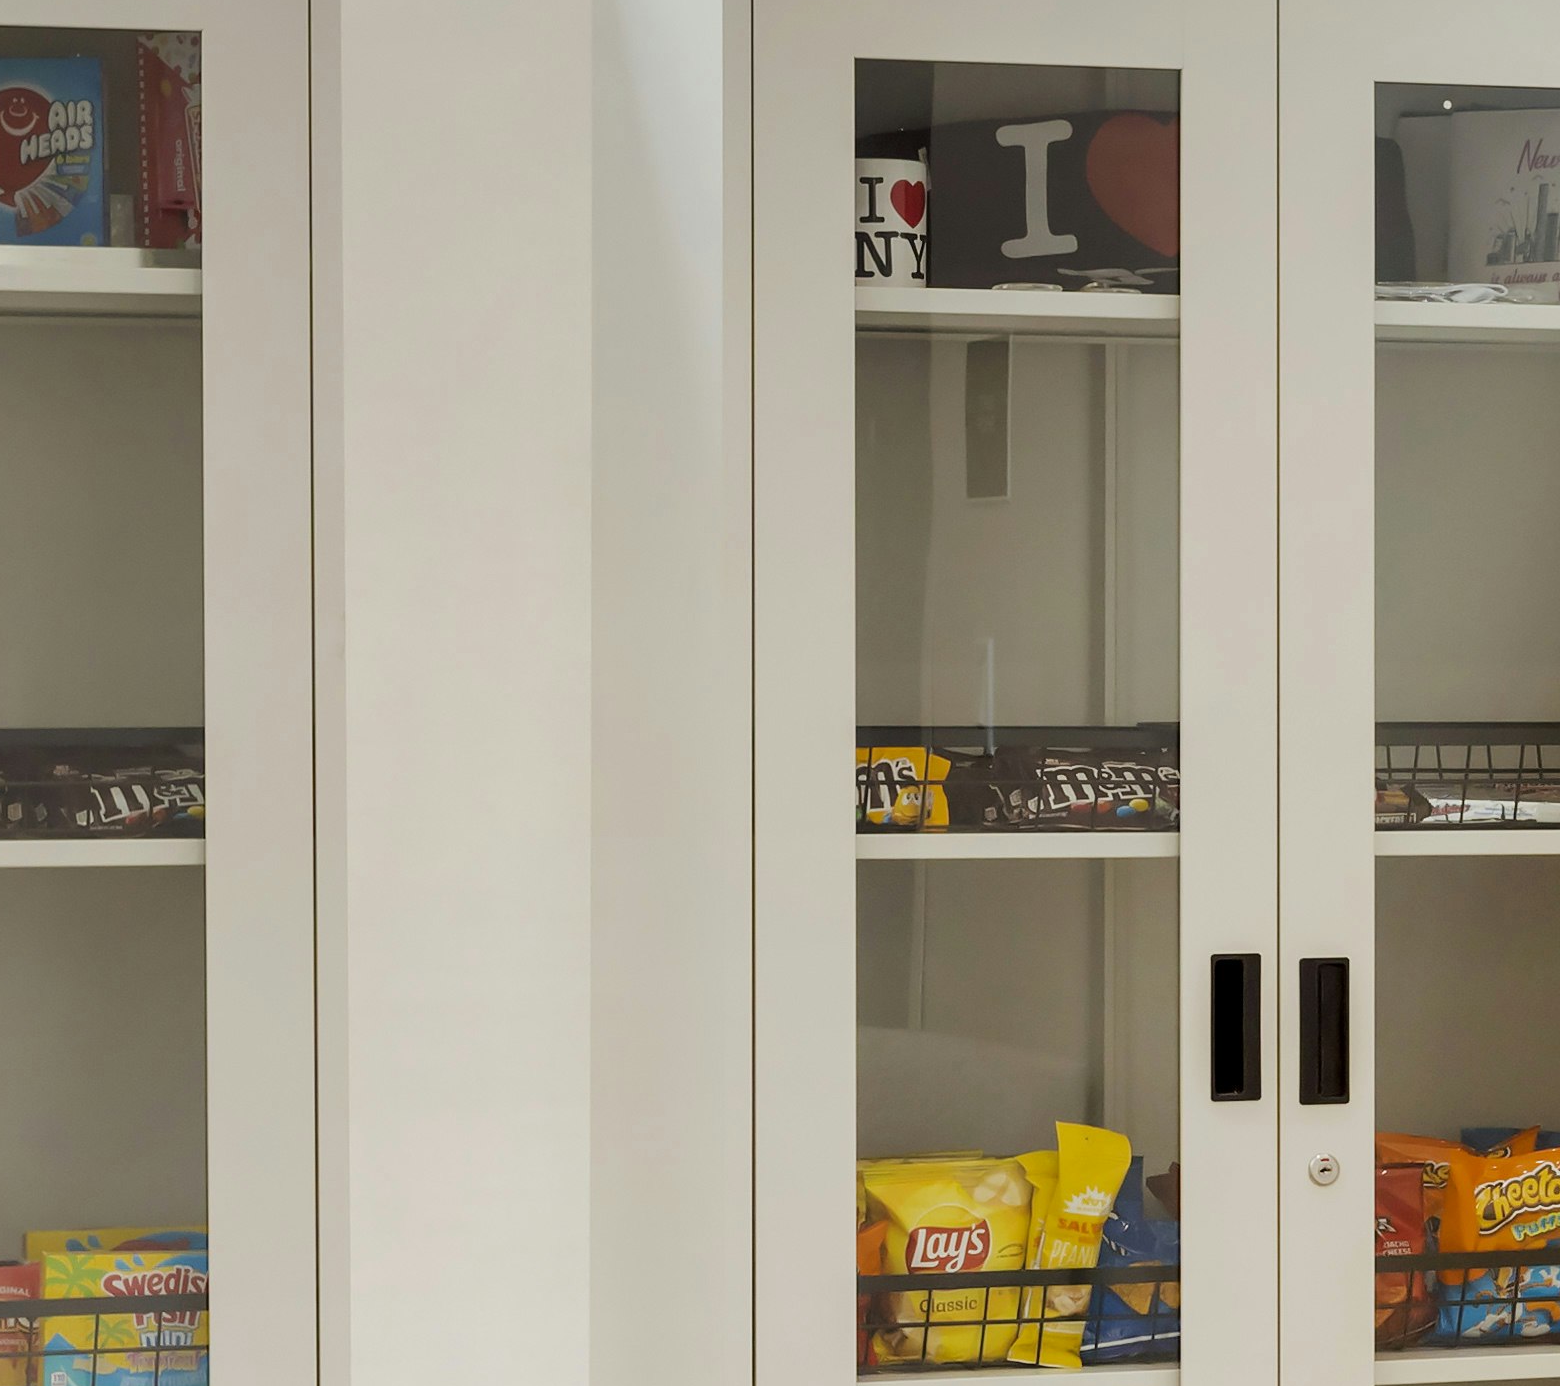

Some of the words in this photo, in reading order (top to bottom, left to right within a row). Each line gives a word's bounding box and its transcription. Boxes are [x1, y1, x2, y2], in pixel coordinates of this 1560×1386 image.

[48, 100, 93, 132] AIR
[20, 125, 93, 164] HEADS
[859, 177, 885, 223] I
[995, 119, 1078, 258] I
[854, 231, 926, 279] NY
[1552, 271, 1560, 282] a
[911, 1224, 986, 1273] Lay's
[919, 1296, 978, 1313] Classic
